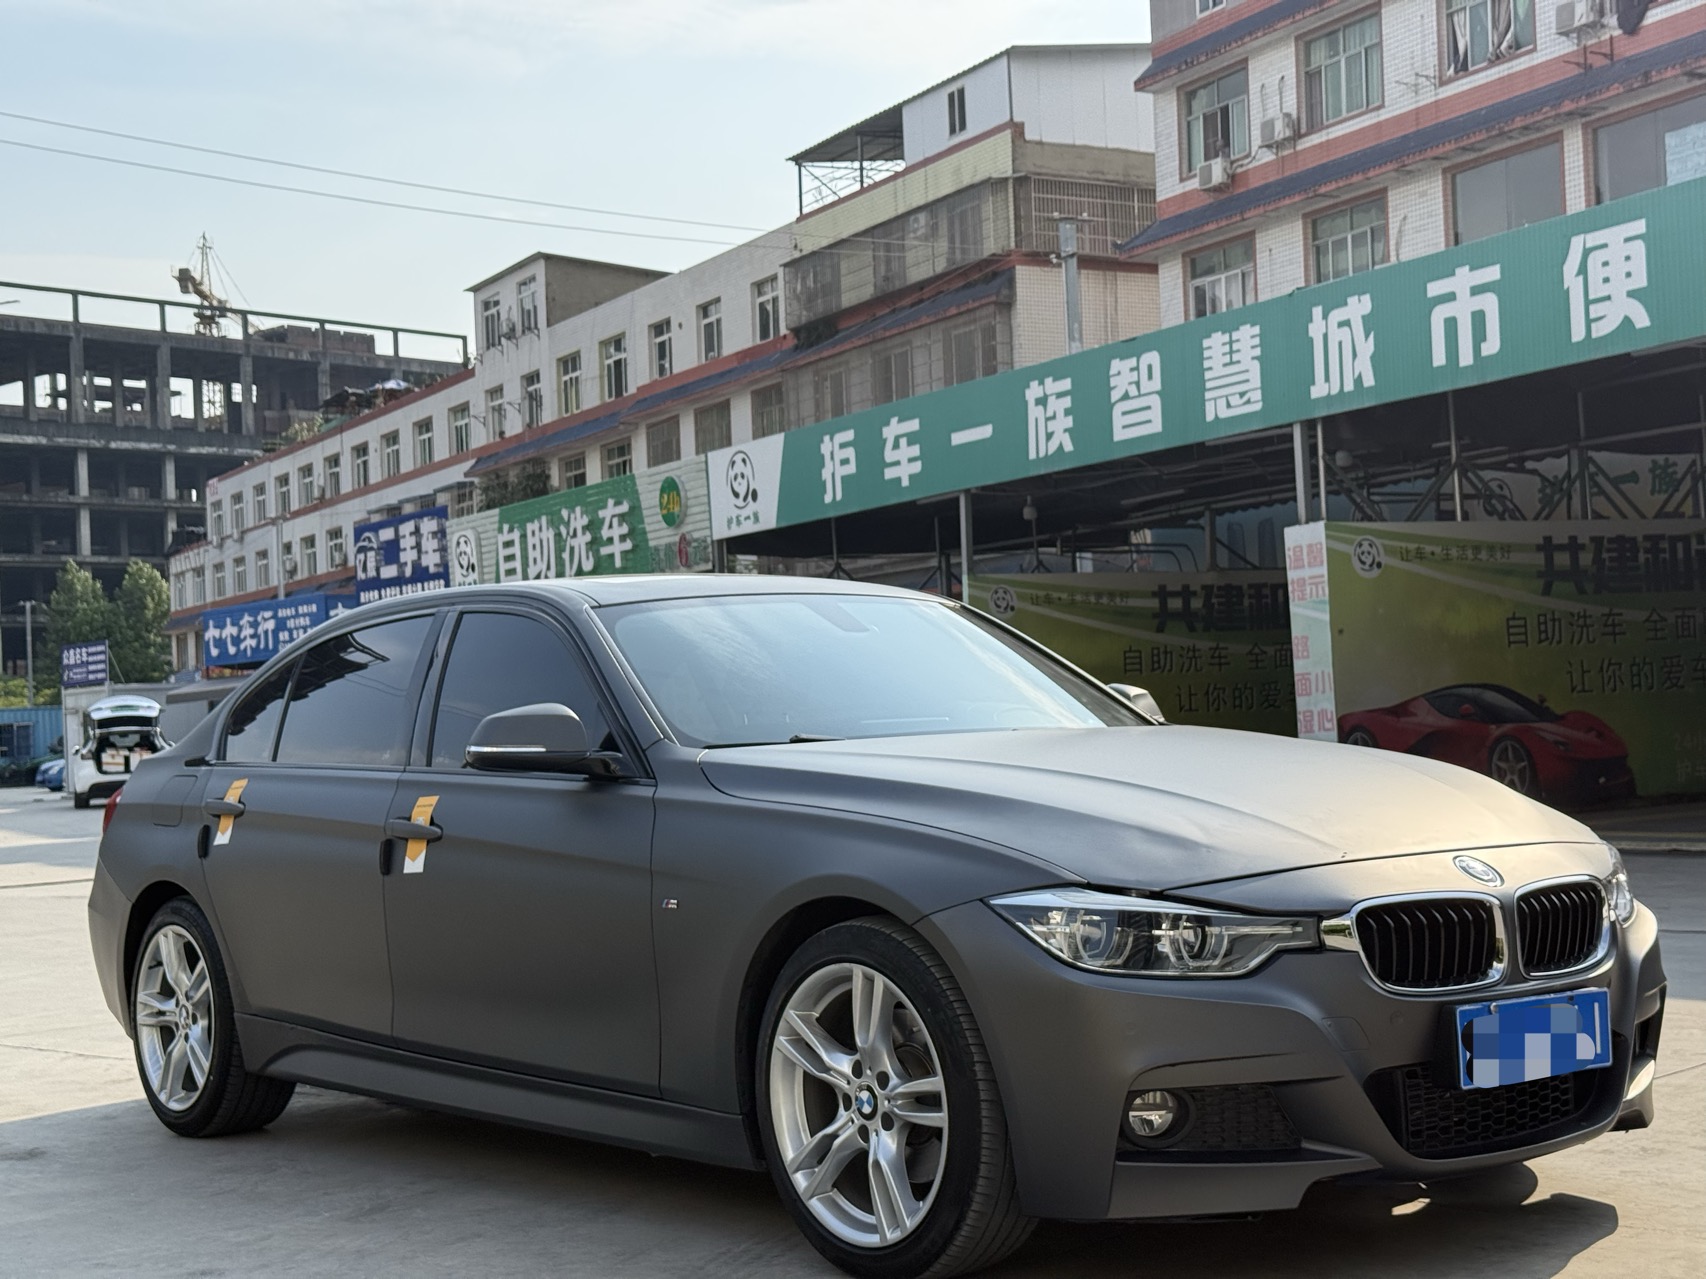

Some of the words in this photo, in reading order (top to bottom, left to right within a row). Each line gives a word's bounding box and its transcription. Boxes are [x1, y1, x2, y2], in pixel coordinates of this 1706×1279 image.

[378, 515, 444, 580] 二手车
[497, 498, 633, 582] 自助洗车
[1287, 542, 1325, 571] 温馨
[1535, 534, 1706, 596] 共建和
[1289, 574, 1327, 602] 提示
[204, 610, 276, 658] 七七车行
[1505, 608, 1627, 648] 自助洗车
[1643, 606, 1706, 642] 全面
[1122, 642, 1231, 676] 自助洗车
